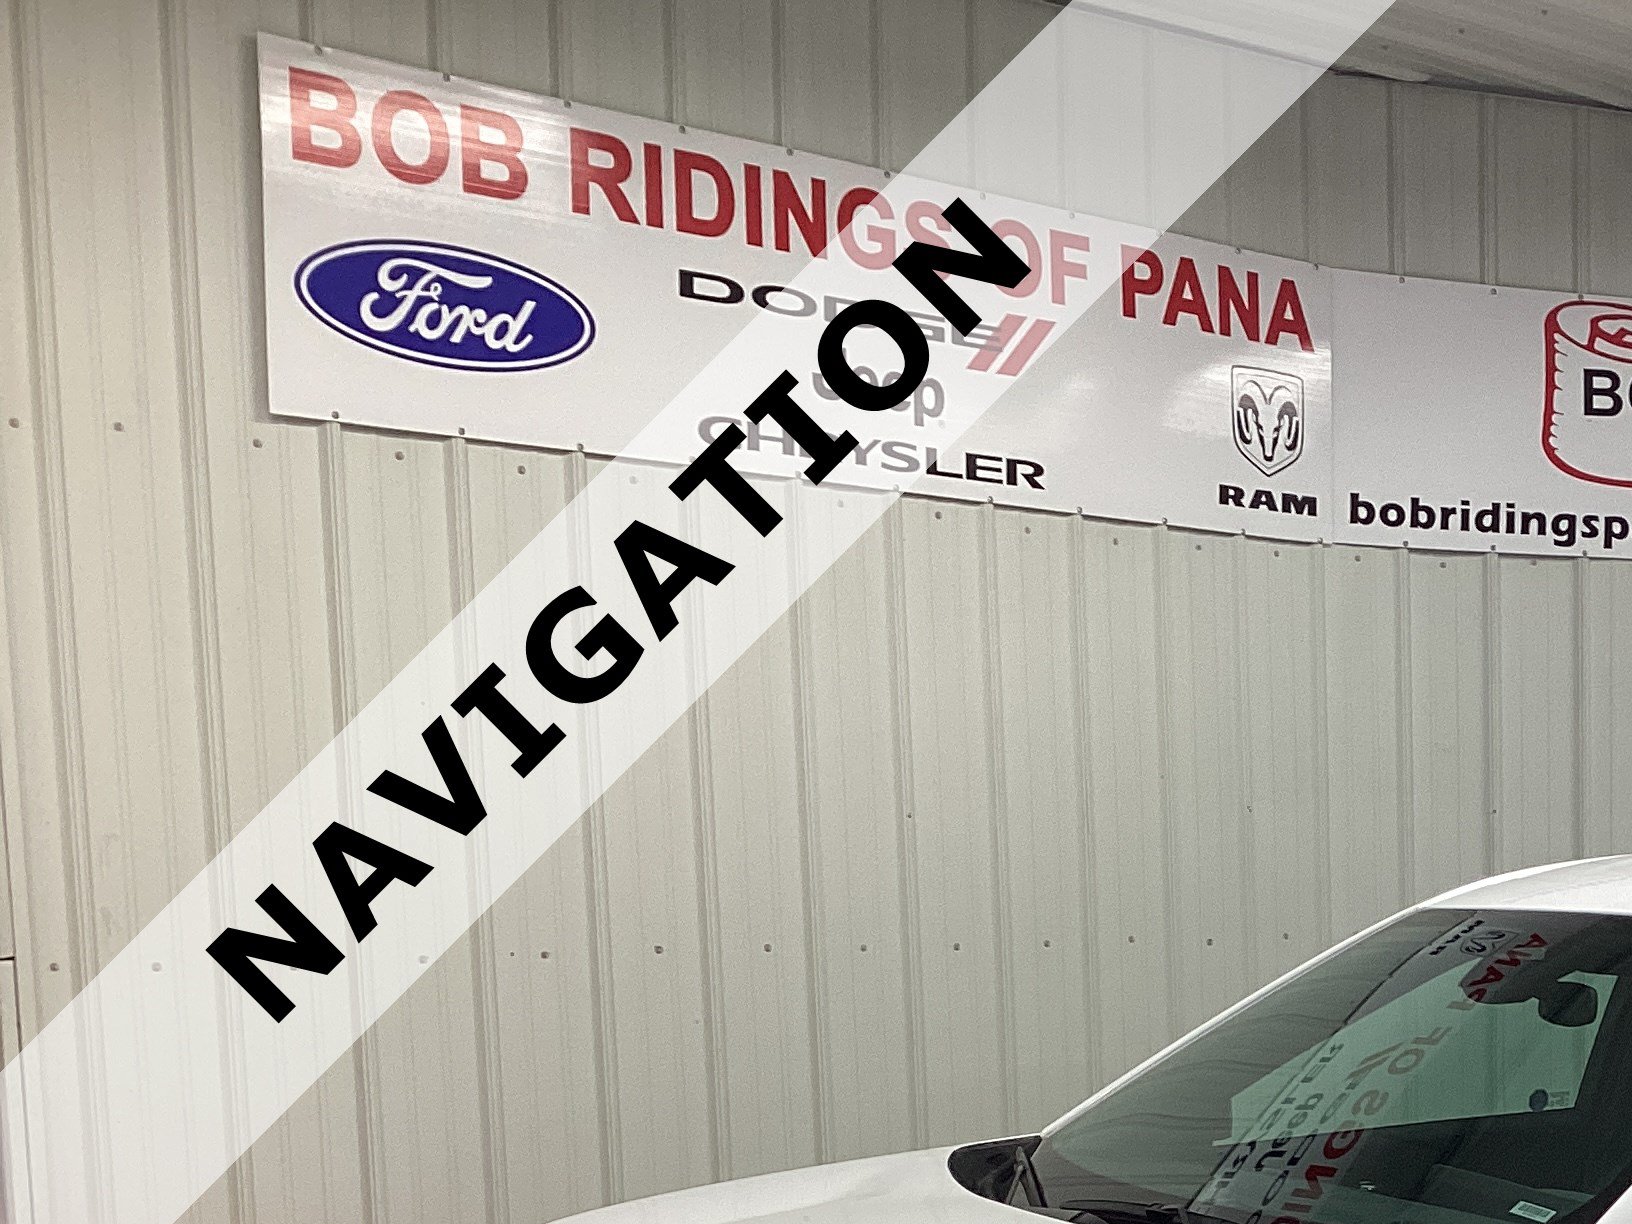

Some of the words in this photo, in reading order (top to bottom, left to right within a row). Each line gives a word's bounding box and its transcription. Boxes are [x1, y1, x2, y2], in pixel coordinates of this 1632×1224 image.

[288, 65, 529, 201] BOB
[986, 218, 1091, 306] OF
[1119, 243, 1315, 353] PANA
[359, 257, 537, 353] Ford
[1218, 483, 1319, 517] RAM
